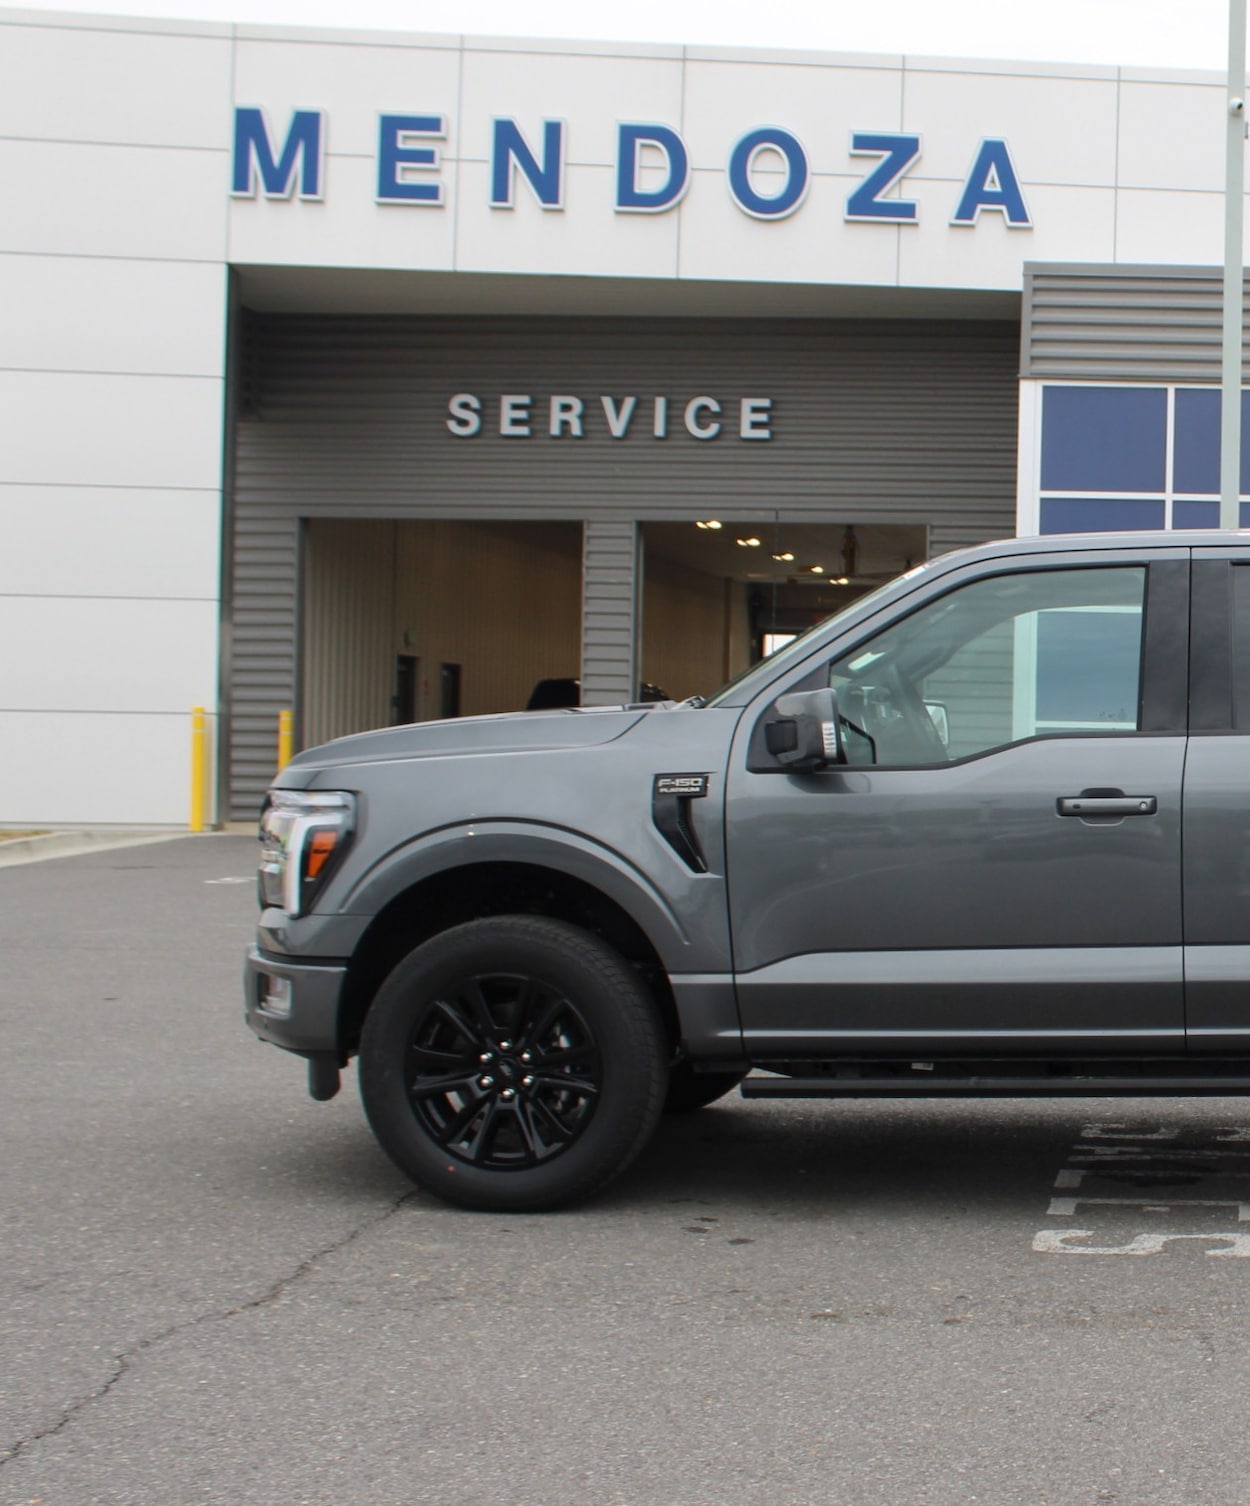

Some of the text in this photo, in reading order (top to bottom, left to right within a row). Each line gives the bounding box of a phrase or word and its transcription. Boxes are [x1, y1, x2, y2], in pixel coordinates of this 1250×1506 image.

[230, 105, 1035, 230] MENDOZA
[446, 393, 775, 440] SERVICE
[658, 778, 702, 787] F-150
